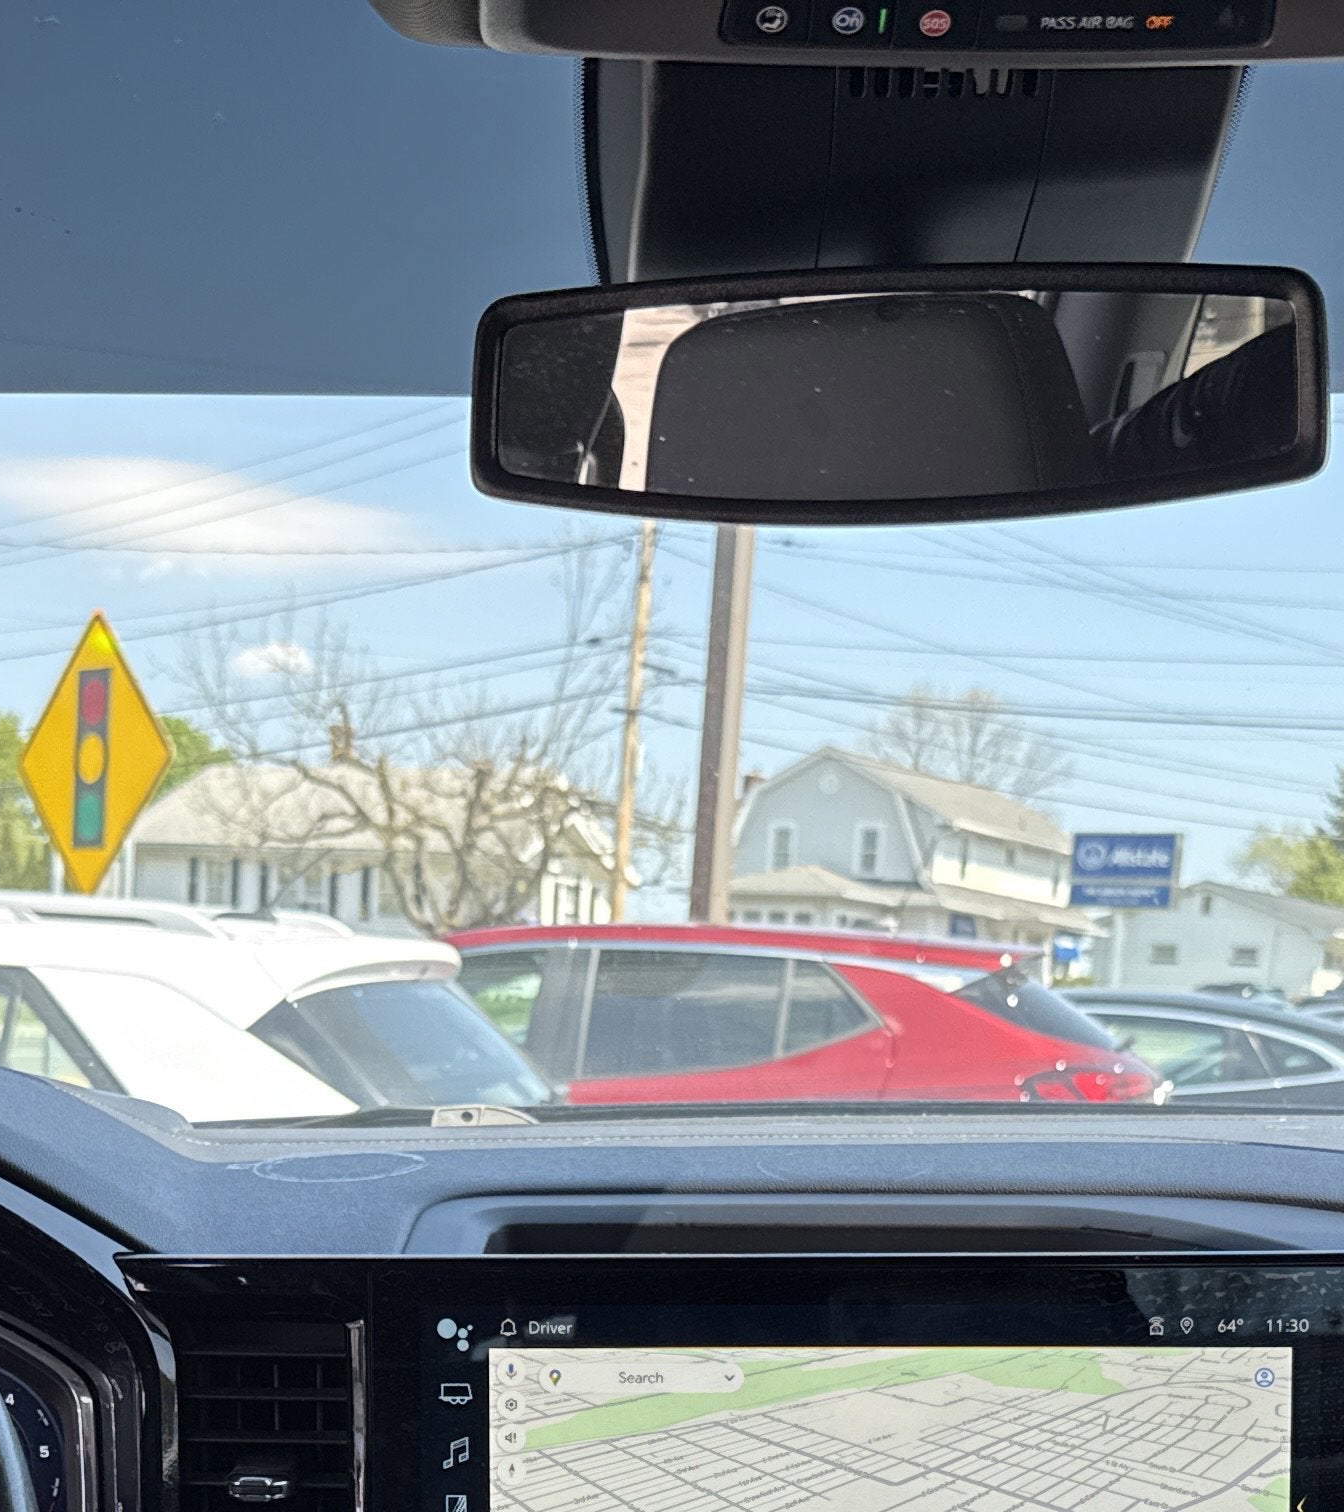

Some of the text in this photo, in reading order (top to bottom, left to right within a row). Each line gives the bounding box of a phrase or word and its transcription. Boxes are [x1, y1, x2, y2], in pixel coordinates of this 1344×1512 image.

[1040, 16, 1174, 30] PASS AIR BAG OFF
[528, 1320, 573, 1336] Driver
[1266, 1318, 1310, 1333] 11:30
[618, 1371, 664, 1385] Search
[39, 1445, 50, 1459] 5
